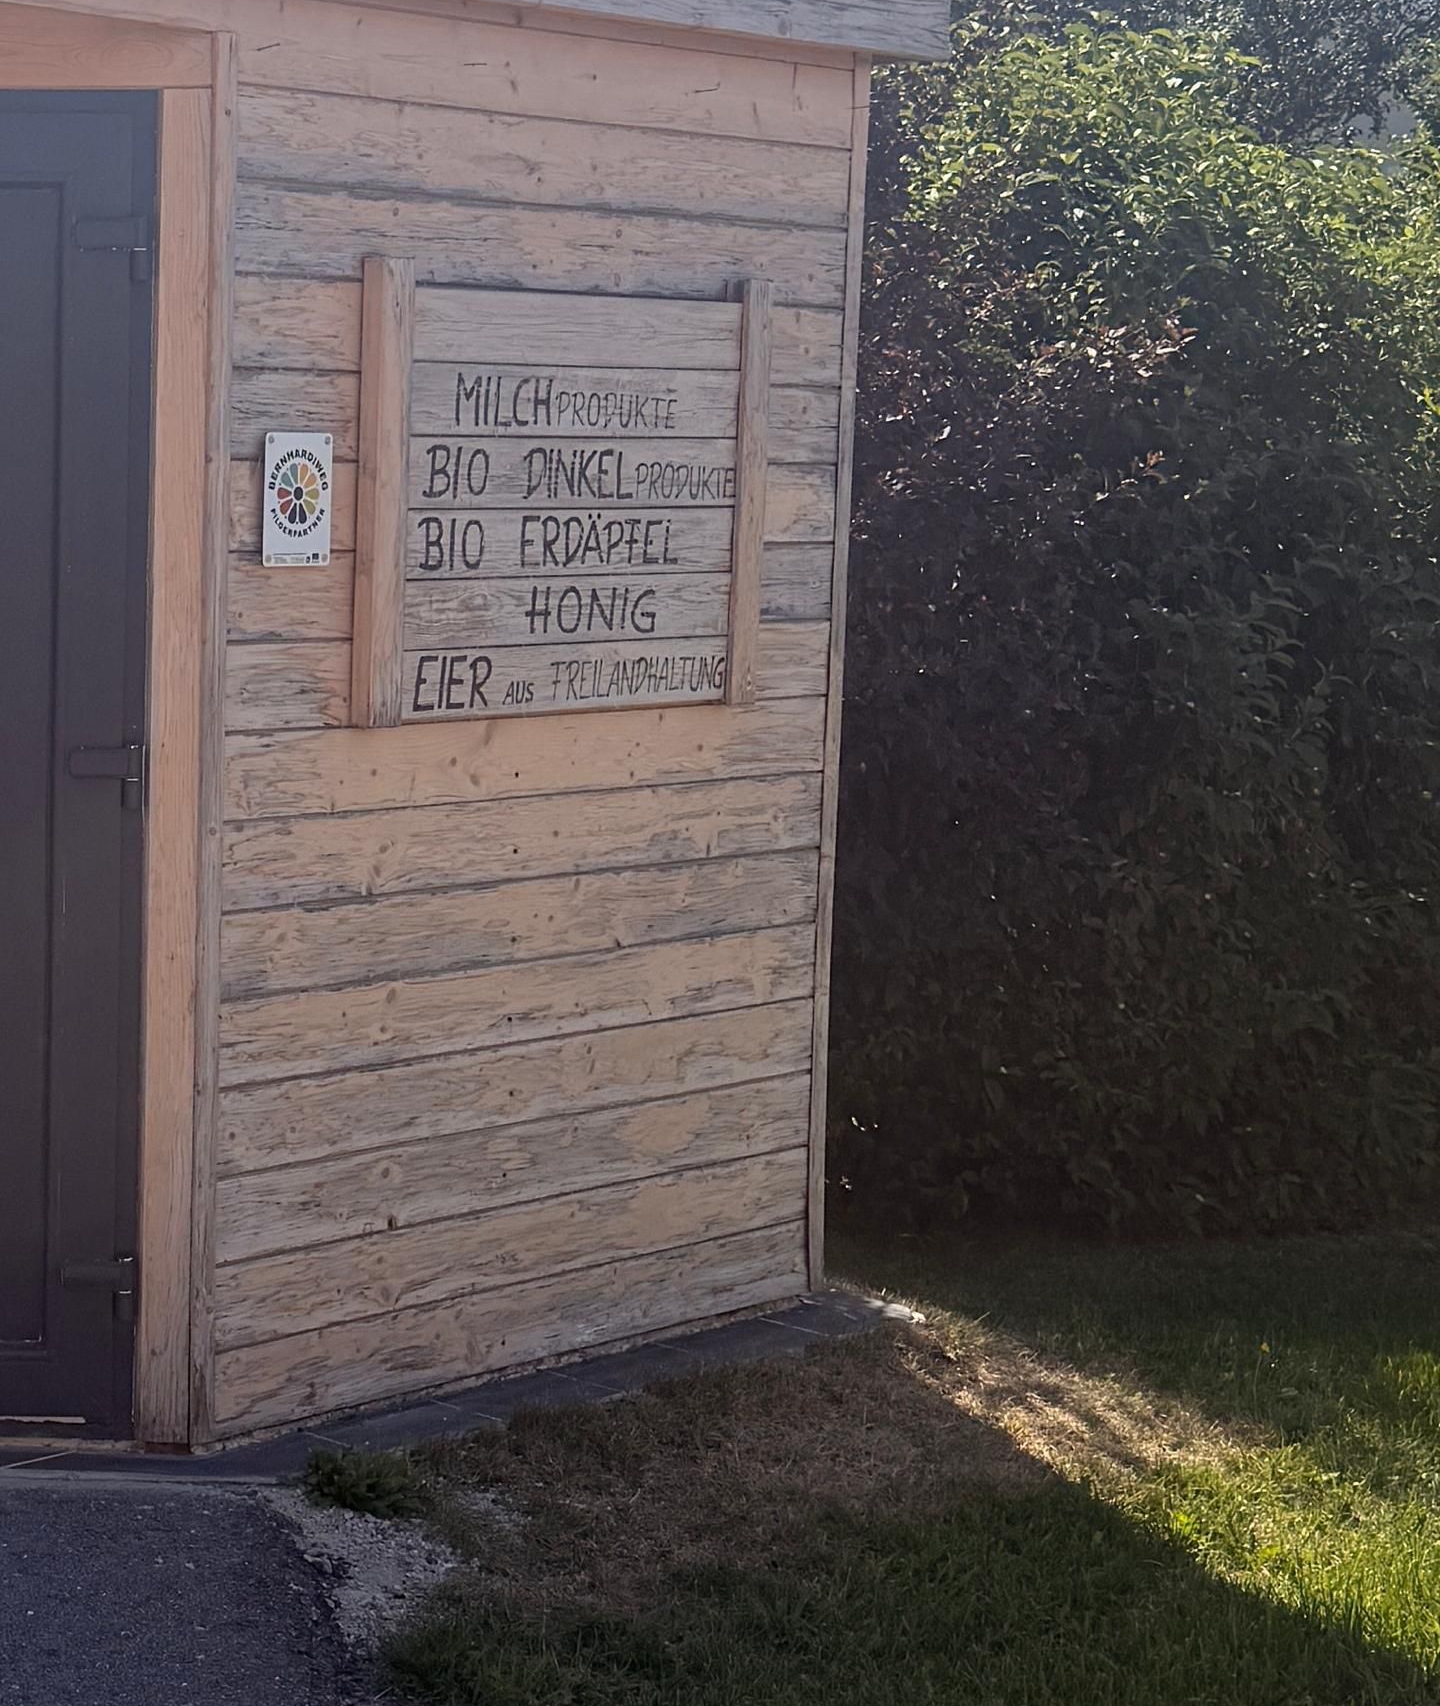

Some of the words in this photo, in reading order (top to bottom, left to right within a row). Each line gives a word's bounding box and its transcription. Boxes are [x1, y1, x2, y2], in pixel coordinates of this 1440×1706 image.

[422, 444, 490, 500] BIO
[417, 516, 486, 572] BIO
[519, 512, 679, 570] ERDÄPFEL
[524, 585, 657, 635] HONIG
[412, 654, 493, 712] EIER
[502, 679, 535, 706] AUS
[550, 655, 726, 701] FREILANDHALTUNG
